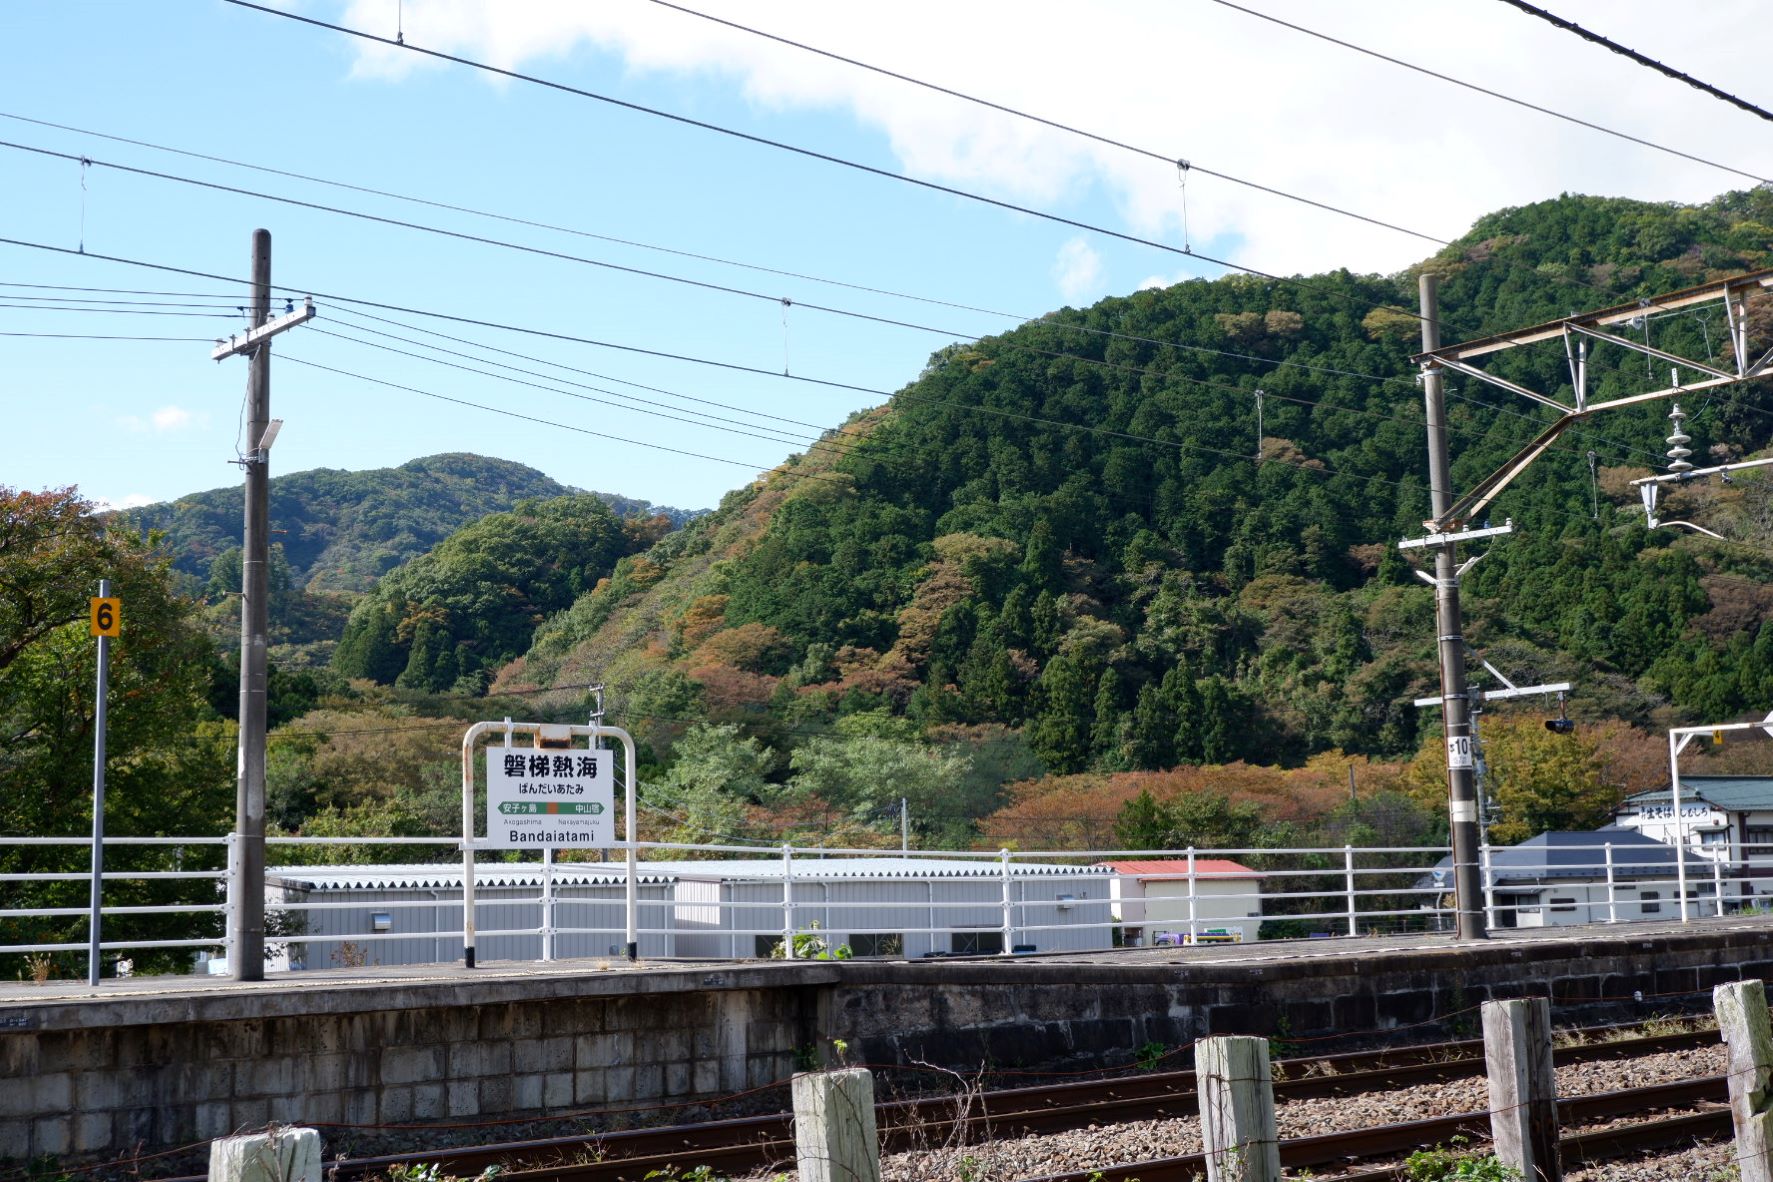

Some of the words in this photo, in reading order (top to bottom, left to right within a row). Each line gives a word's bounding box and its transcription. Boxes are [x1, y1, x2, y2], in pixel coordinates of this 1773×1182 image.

[97, 603, 113, 630] 6
[1455, 739, 1468, 755] 10
[504, 754, 597, 779] 磐梯熱海
[519, 783, 584, 795] ばんだいあたみ
[575, 803, 600, 813] 中山宿
[510, 830, 594, 842] Bandaiatami
